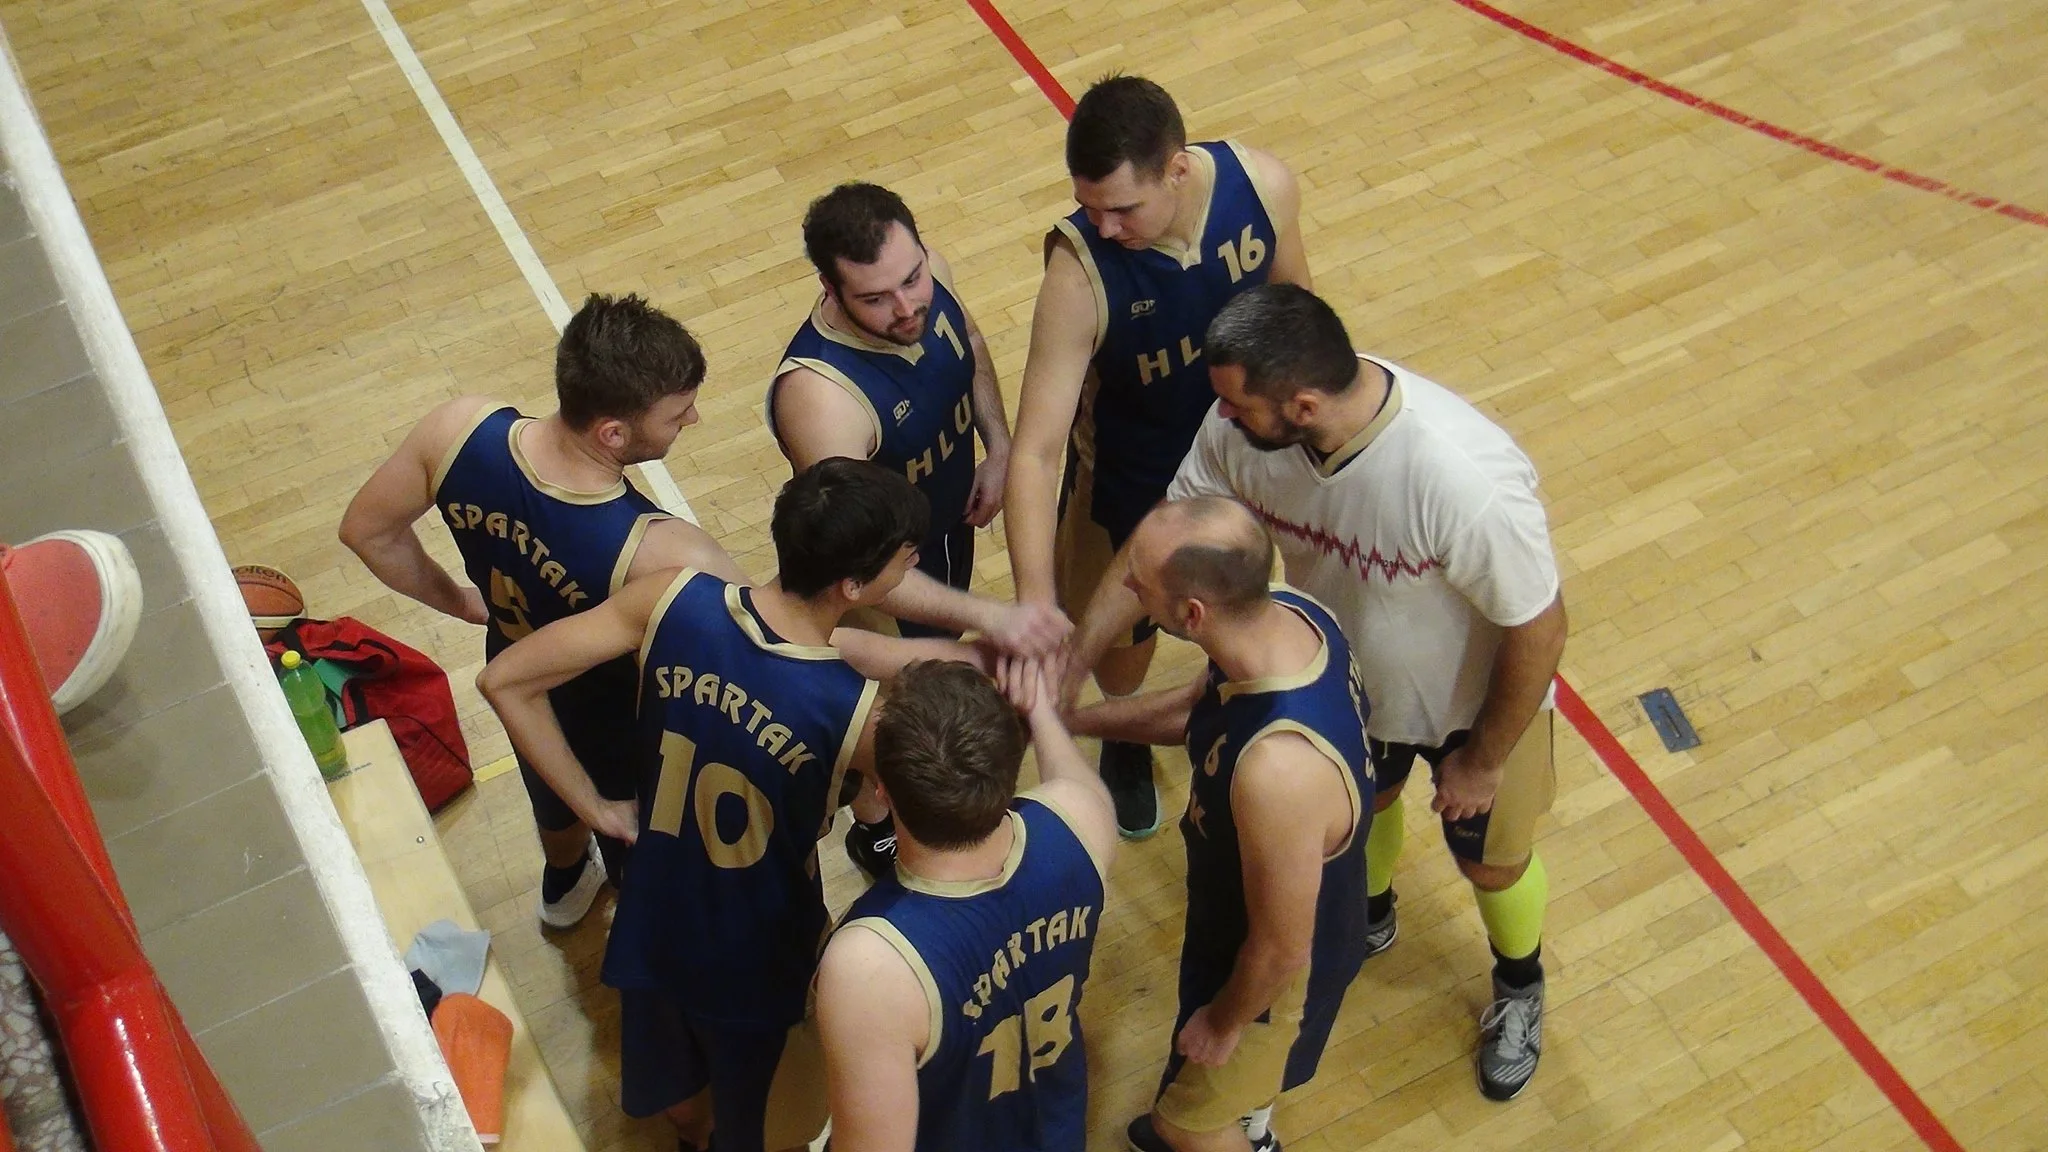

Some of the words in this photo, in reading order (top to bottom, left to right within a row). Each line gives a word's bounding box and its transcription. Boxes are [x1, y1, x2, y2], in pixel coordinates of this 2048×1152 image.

[1217, 224, 1266, 284] 16
[1136, 335, 1202, 386] HL
[447, 502, 589, 607] SPARTAK
[656, 667, 818, 775] SPARTAK
[649, 729, 774, 868] 10
[963, 906, 1092, 1021] SPARTAK
